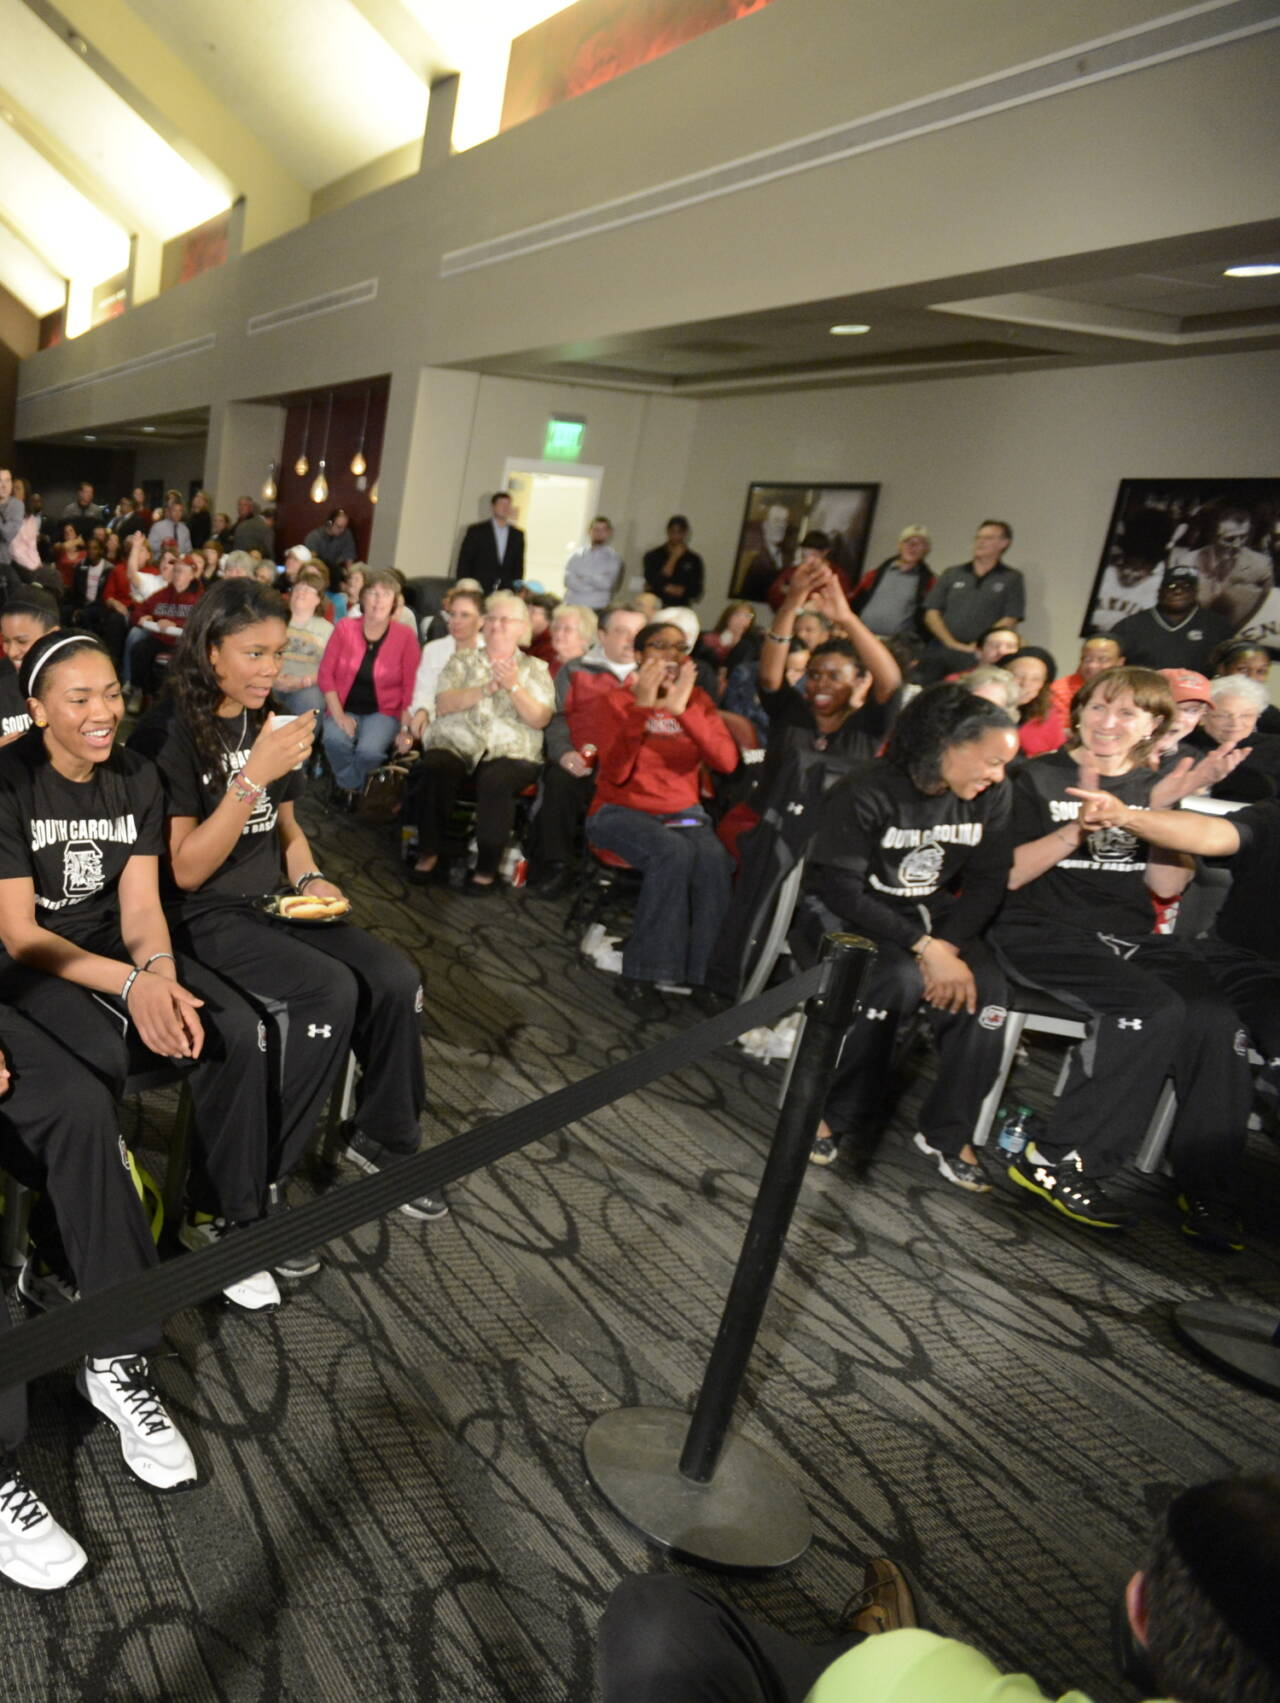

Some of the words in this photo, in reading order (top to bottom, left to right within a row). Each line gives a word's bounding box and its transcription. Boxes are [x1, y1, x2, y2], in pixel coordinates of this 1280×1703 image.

[30, 818, 68, 852] SOUTH
[69, 813, 138, 845] CAROLINA
[881, 826, 921, 849] OUTH
